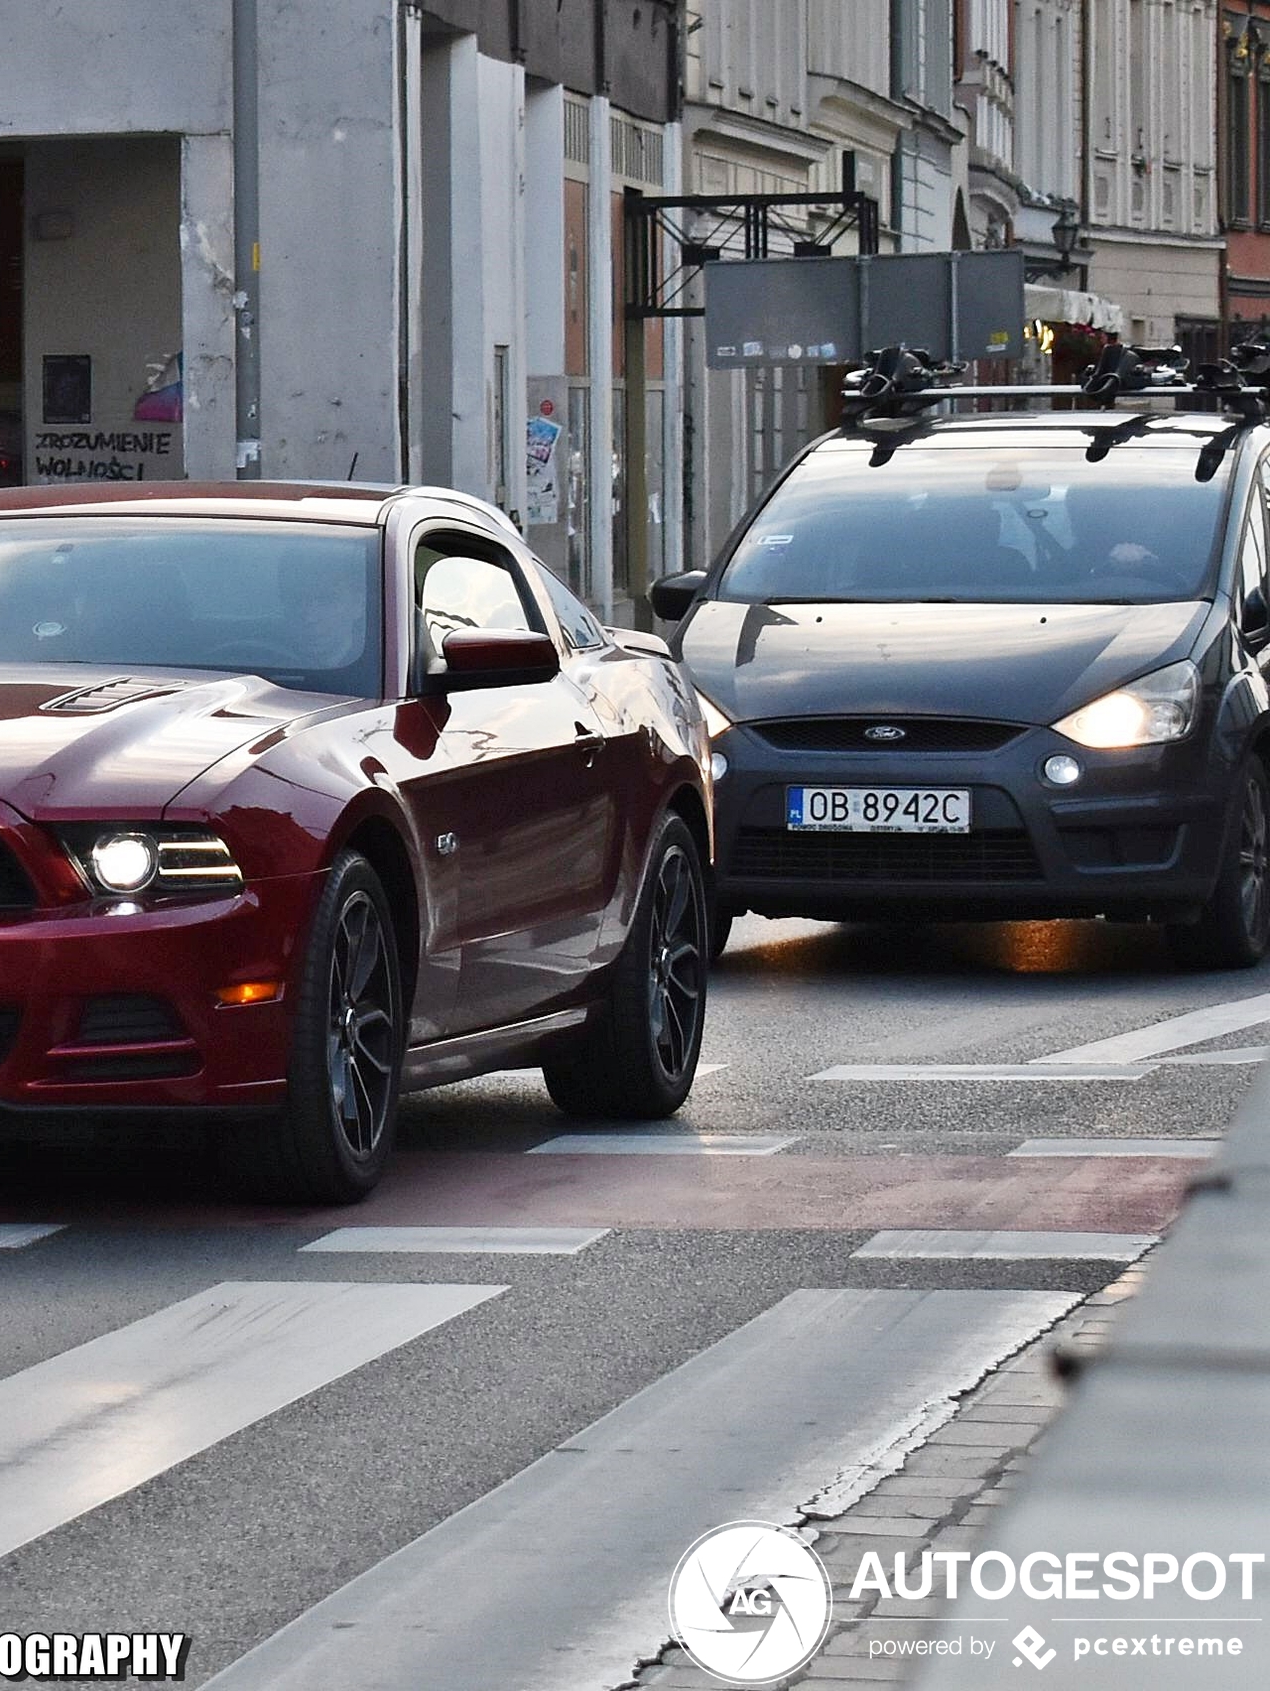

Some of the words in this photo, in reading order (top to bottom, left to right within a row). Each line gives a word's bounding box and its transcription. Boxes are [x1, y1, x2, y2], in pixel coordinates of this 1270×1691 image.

[35, 432, 171, 454] ZROZUMIENIE
[35, 456, 143, 481] WOLNOŚCI
[810, 792, 849, 822] OB
[863, 792, 961, 823] 8942C
